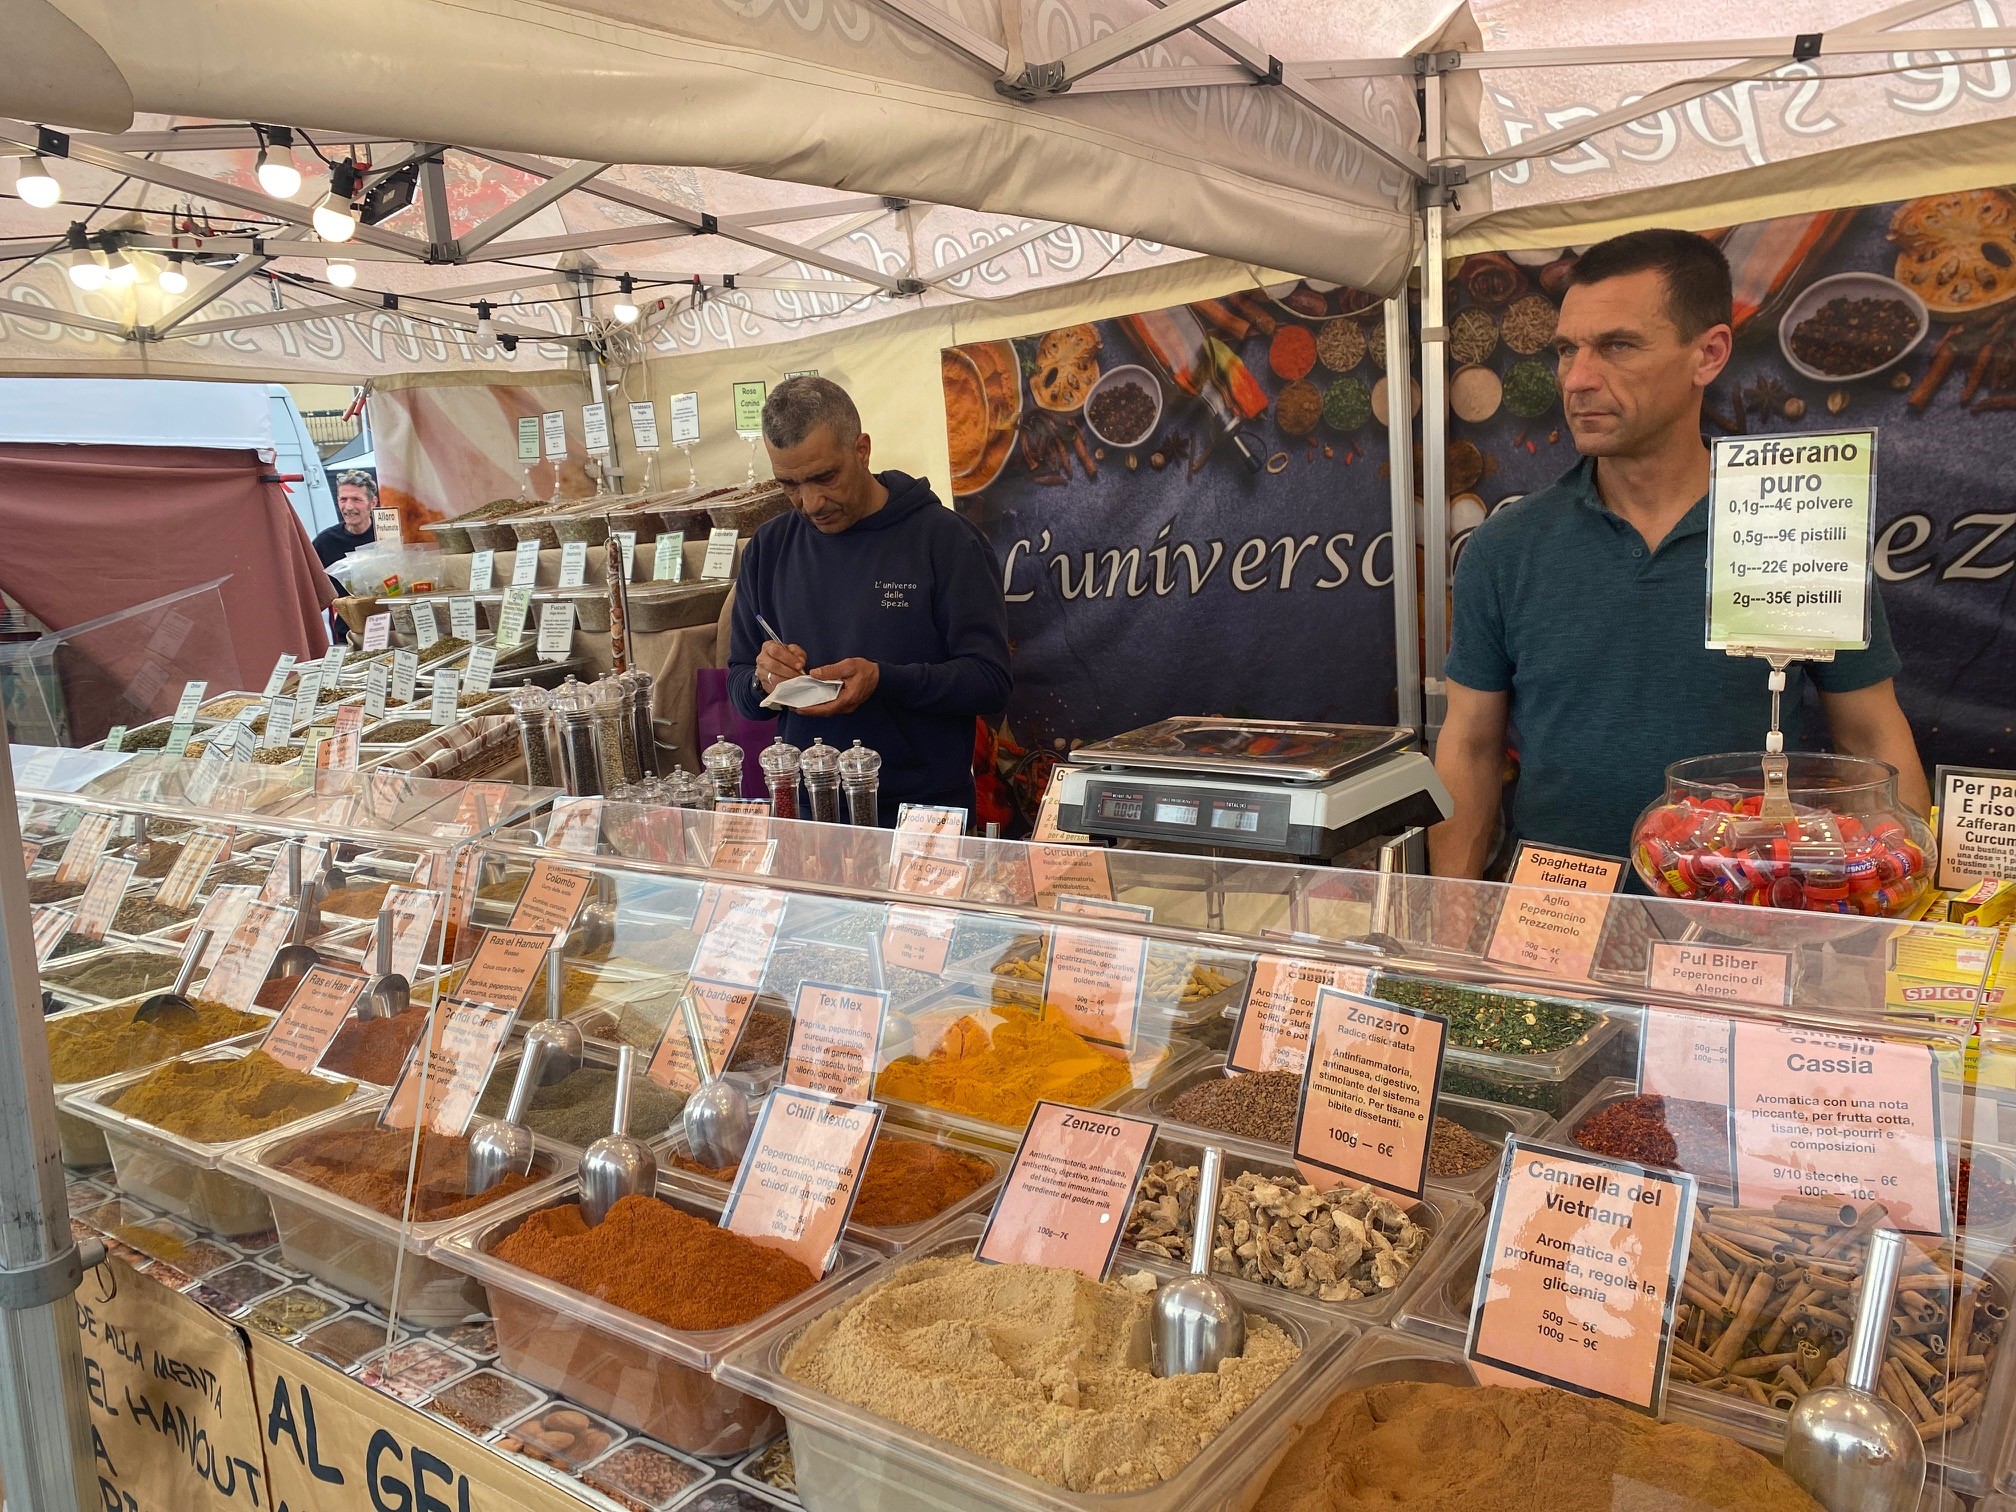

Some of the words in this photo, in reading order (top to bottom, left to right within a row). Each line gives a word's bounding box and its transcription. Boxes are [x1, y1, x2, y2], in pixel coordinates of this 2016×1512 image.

[1728, 442, 1857, 467] Zafferano
[1760, 474, 1822, 499] puro
[1797, 497, 1853, 513] polvere
[378, 513, 395, 521] Alloro
[1801, 527, 1846, 545] pistilli
[1793, 560, 1848, 575] polvere
[881, 600, 909, 609] Spezie
[1797, 591, 1841, 607] pistilli
[1953, 779, 1984, 795] Per
[1964, 799, 1973, 813] E
[927, 815, 961, 826] Vegetale
[1043, 847, 1088, 858] Curcuma
[1531, 853, 1607, 876] Spaghettata
[545, 873, 576, 888] Colombo
[1541, 871, 1587, 889] italiana
[1543, 894, 1569, 907] Aglio
[1520, 902, 1585, 924] Peperoncino
[1519, 915, 1579, 937] Prezzemolo
[489, 935, 504, 945] Ras
[515, 938, 544, 950] Hanout
[1680, 951, 1707, 966] Pul
[1713, 954, 1758, 970] Biber
[309, 974, 324, 987] Ras
[325, 979, 332, 989] el
[1073, 977, 1095, 986] golden
[1673, 967, 1747, 984] Peperoncino
[1752, 976, 1762, 985] di
[706, 990, 747, 1005] barbecue
[1695, 983, 1737, 996] Aleppo
[820, 994, 836, 1007] Tex
[840, 997, 862, 1011] Mex
[800, 1019, 826, 1032] Paprika,
[828, 1025, 872, 1039] peperoncino,
[1347, 1007, 1410, 1036] Zenzero
[1338, 1024, 1367, 1039] Radice
[801, 1044, 822, 1053] chiodi
[1333, 1048, 1412, 1078] Antinfiammatoria,
[1787, 1053, 1873, 1074] Cassia
[1322, 1059, 1372, 1081] antinausea,
[1375, 1073, 1420, 1095] digestivo,
[809, 1081, 826, 1090] pepe
[828, 1085, 843, 1094] nero
[1319, 1070, 1364, 1092] stimolante
[1367, 1083, 1381, 1096] del
[1383, 1088, 1420, 1107] sistema
[1312, 1081, 1366, 1105] immunitario.
[1369, 1098, 1383, 1110] Per
[1387, 1103, 1415, 1120] tisane
[1418, 1113, 1424, 1121] e
[1756, 1093, 1819, 1106] Aromatica
[1824, 1098, 1847, 1107] con
[1851, 1100, 1874, 1109] una
[1879, 1100, 1908, 1110] nota
[786, 1102, 816, 1121] Chili
[817, 1110, 859, 1131] Mexico
[1328, 1099, 1353, 1115] bibite
[1354, 1108, 1402, 1129] dissetanti.
[1752, 1109, 1808, 1122] piccante,
[1813, 1113, 1833, 1122] per
[1837, 1111, 1872, 1123] frutta
[1876, 1114, 1915, 1127] cotta,
[1061, 1114, 1121, 1137] Zenzero
[1772, 1124, 1813, 1137] tisane,
[1816, 1127, 1882, 1140] pot-pourri
[1887, 1131, 1894, 1139] e
[1328, 1127, 1358, 1148] 100g
[1377, 1142, 1394, 1157] 6€
[1791, 1140, 1876, 1154] composizioni
[1029, 1150, 1088, 1170] Antinfiammatorio,
[1088, 1164, 1127, 1178] antinausea,
[755, 1161, 779, 1175] aglio,
[817, 1176, 849, 1194] origano,
[1022, 1160, 1057, 1175] antisettico,
[1059, 1167, 1090, 1182] digestivo,
[1091, 1176, 1127, 1189] stimolante
[1528, 1160, 1620, 1197] Cannella
[1628, 1184, 1662, 1206] del
[1773, 1169, 1801, 1180] 9/10
[1806, 1172, 1858, 1184] stecche
[1881, 1176, 1898, 1186] 6€
[761, 1176, 788, 1192] chiodi
[790, 1184, 797, 1195] di
[1030, 1173, 1040, 1181] del
[1041, 1177, 1067, 1188] sistema
[1068, 1182, 1109, 1197] immunitario.
[1022, 1182, 1060, 1198] Ingrediente
[1061, 1192, 1071, 1200] del
[1072, 1194, 1095, 1205] golden
[1095, 1200, 1111, 1209] milk
[1851, 1190, 1875, 1200] 10€
[1545, 1191, 1633, 1229] Vietnam
[1536, 1232, 1613, 1264] Aromatica
[1618, 1255, 1628, 1267] e
[1504, 1245, 1583, 1278] profumata,
[1588, 1267, 1637, 1291] regola
[1642, 1280, 1656, 1295] la
[1543, 1276, 1607, 1303] glicemia
[1542, 1309, 1563, 1326] 50g
[1582, 1321, 1598, 1334] 5€
[1537, 1324, 1564, 1343] 100g
[1583, 1338, 1598, 1351] 9€
[105, 1322, 145, 1371] ALLA
[153, 1350, 222, 1419] MENTA
[84, 1356, 119, 1416] EL
[125, 1386, 261, 1507] HANOUT
[268, 1375, 344, 1485] AL
